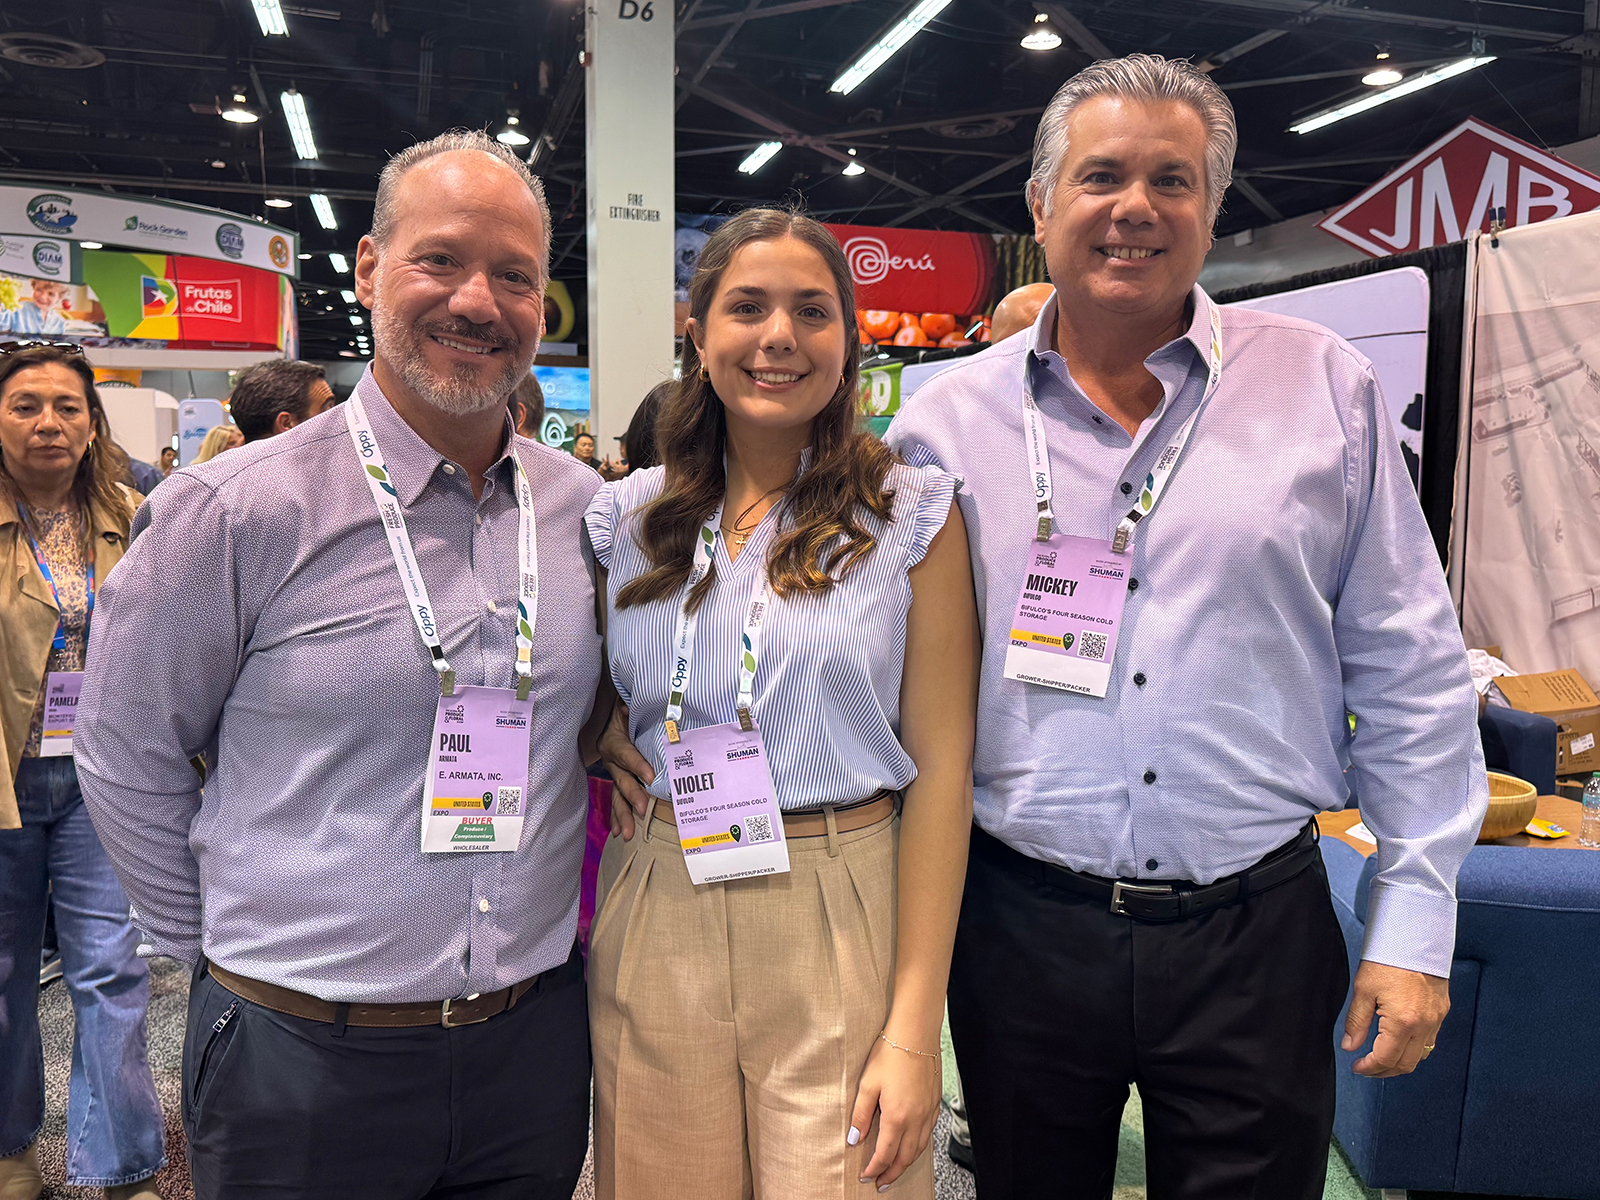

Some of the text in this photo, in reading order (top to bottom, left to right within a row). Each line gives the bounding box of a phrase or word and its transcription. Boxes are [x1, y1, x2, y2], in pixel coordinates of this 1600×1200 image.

[618, 0, 653, 22] D6
[627, 193, 643, 206] FIRE
[1369, 151, 1573, 250] JMB
[610, 206, 660, 222] EXTINGUISHER
[185, 285, 232, 300] Frutas
[194, 300, 233, 314] Chile
[357, 430, 375, 458] Oppy
[1035, 471, 1049, 498] Oppy
[1089, 567, 1124, 578] SHUMAN
[1025, 573, 1078, 597] MICKEY
[416, 604, 435, 637] Oppy
[1019, 611, 1048, 621] STORAGE
[1020, 604, 1114, 626] BIFULCO'S FOUR SEASON COLD
[1011, 639, 1028, 647] EXPO
[672, 656, 687, 688] Oppy
[1016, 673, 1091, 693] GROWER-SHIPPER/PACKER
[496, 718, 526, 726] SHUMAN
[439, 733, 471, 752] PAUL
[438, 755, 457, 763] ARMATA
[726, 748, 759, 759] SHUMAN
[439, 771, 504, 781] E. ARMATA, INC.
[673, 772, 715, 795] VIOLET
[679, 797, 768, 818] BIFULCO'S FOUR SEASON COLD
[680, 815, 708, 824] STORAGE
[704, 867, 776, 882] GROWER-SHIPPER/PACKER
